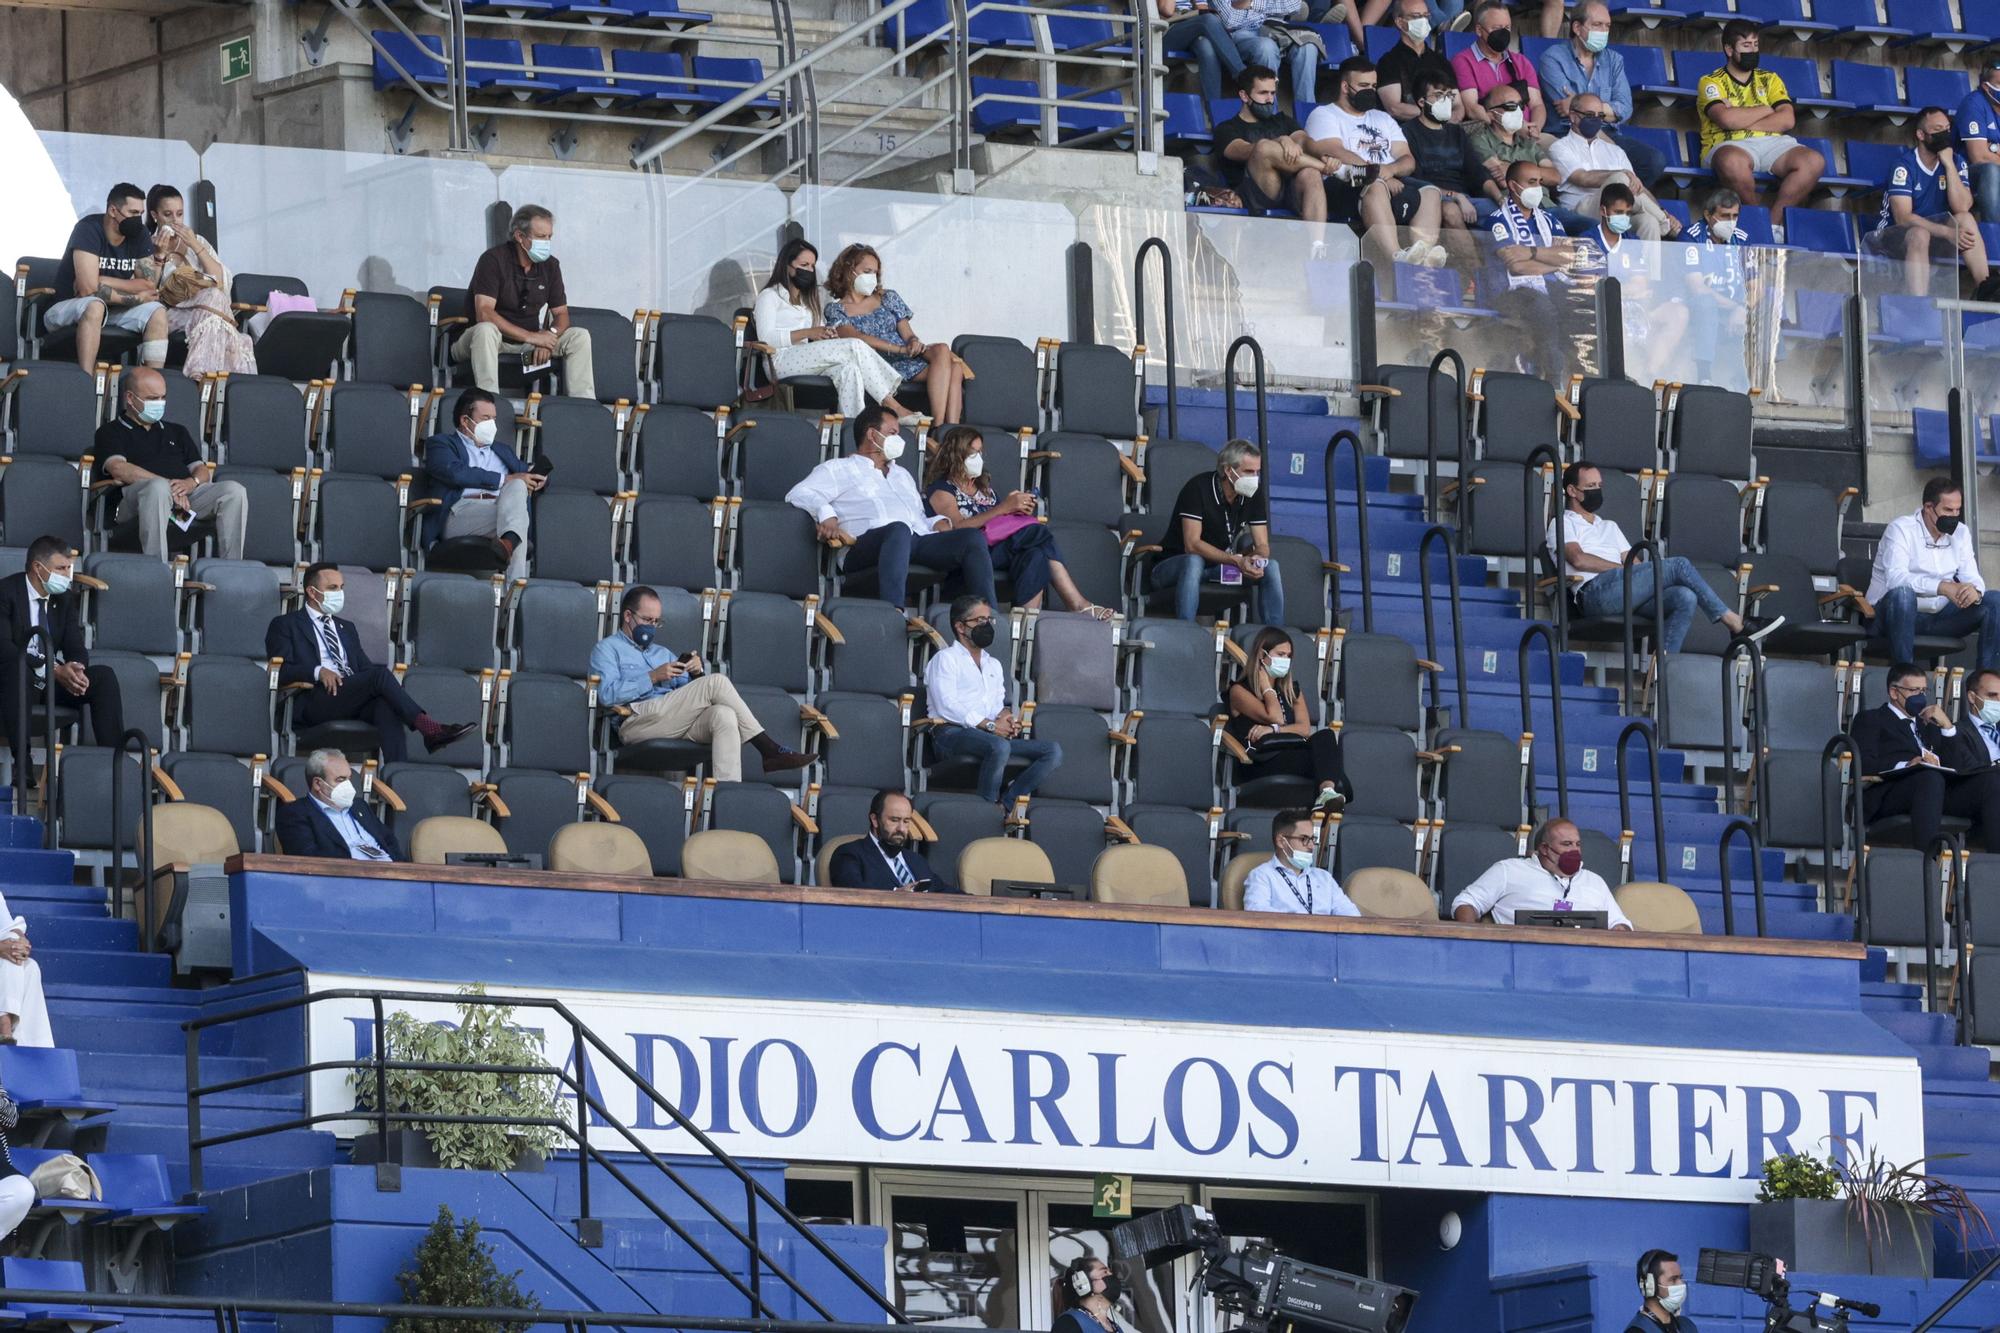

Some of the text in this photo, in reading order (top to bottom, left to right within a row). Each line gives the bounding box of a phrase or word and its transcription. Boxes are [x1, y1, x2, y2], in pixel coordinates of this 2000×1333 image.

[878, 135, 896, 152] 15
[1291, 455, 1302, 474] 6
[1388, 554, 1399, 575] 5
[1583, 750, 1596, 769] 3
[344, 1017, 1884, 1184] ADIO CARLOS TARTIERE
[1287, 1296, 1314, 1309] DIGISUPER
[1358, 1303, 1376, 1312] Canon
